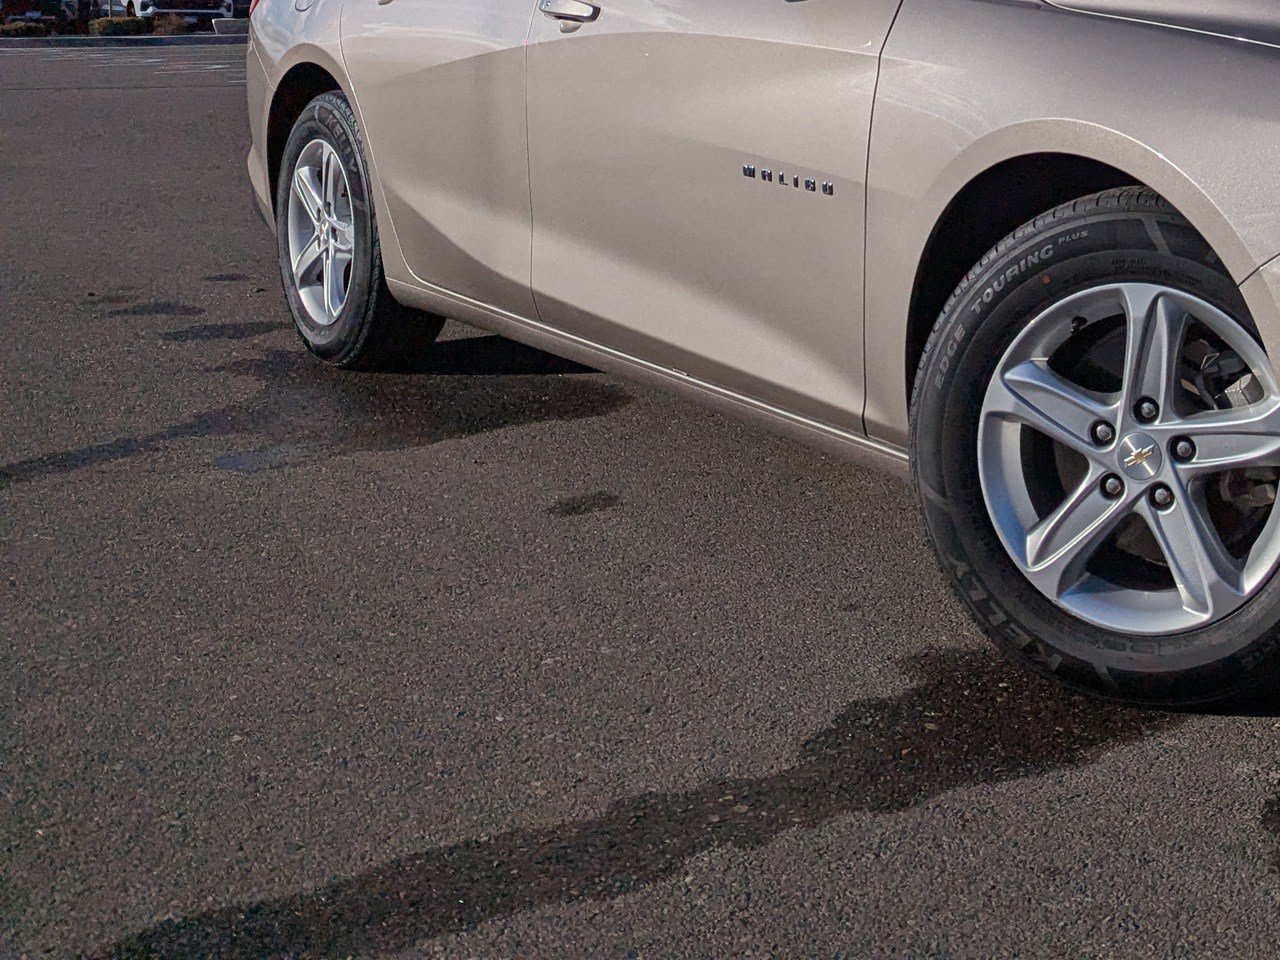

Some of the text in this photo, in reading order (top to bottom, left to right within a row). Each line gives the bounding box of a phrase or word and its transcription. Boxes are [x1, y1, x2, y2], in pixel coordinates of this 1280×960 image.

[742, 164, 834, 196] MALIBU
[934, 323, 966, 390] EDGE
[971, 244, 1055, 314] TOURING
[1058, 230, 1089, 244] PLUS
